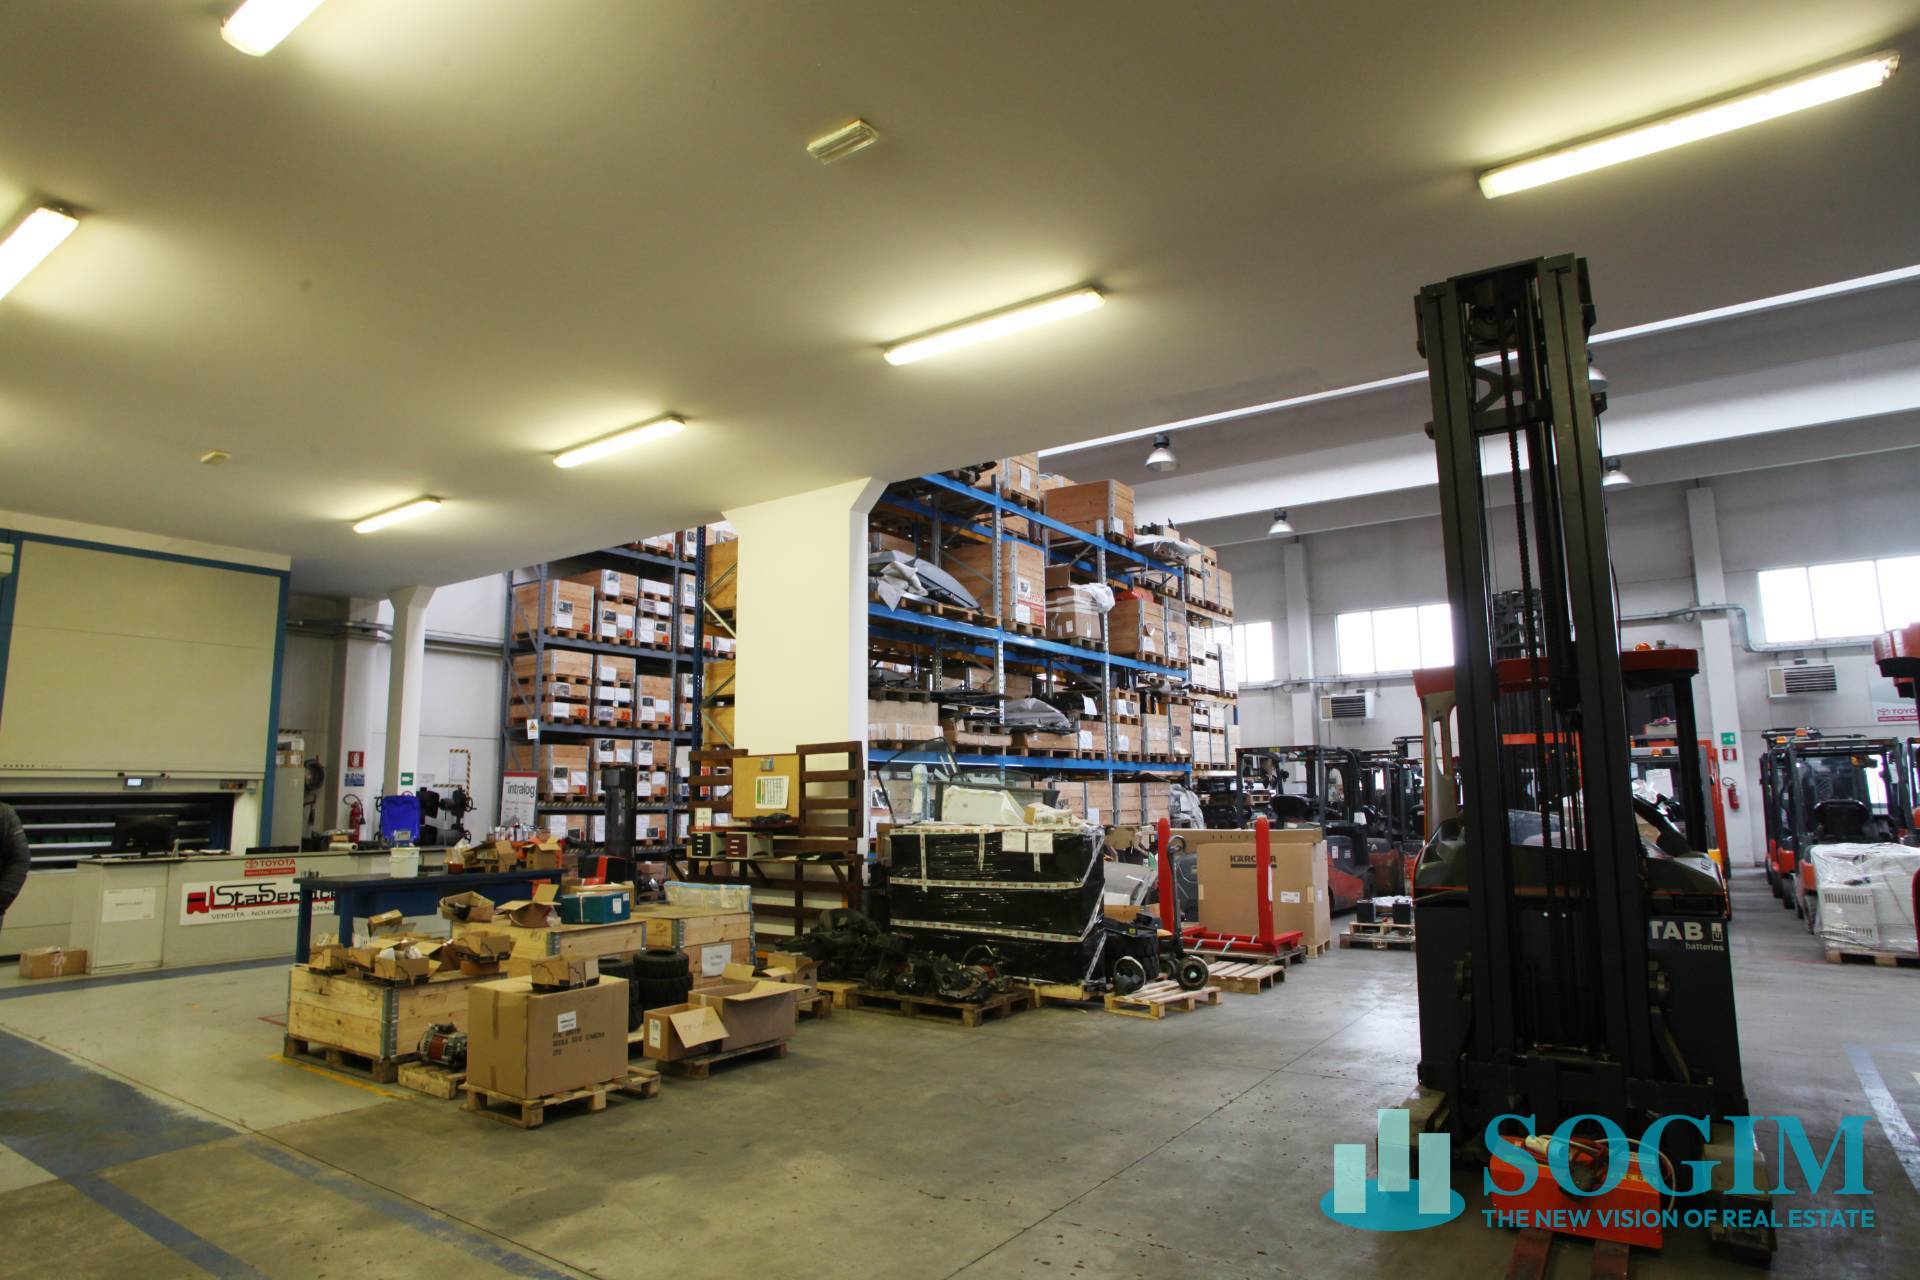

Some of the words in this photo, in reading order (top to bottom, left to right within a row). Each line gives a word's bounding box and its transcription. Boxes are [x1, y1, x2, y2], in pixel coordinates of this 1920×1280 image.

[507, 783, 535, 798] intralog
[260, 858, 296, 868] TOYOTA
[211, 912, 245, 921] VENDITA
[251, 908, 292, 917] NOLEGGIO
[1648, 920, 1704, 941] TAB
[1685, 943, 1725, 951] batteries
